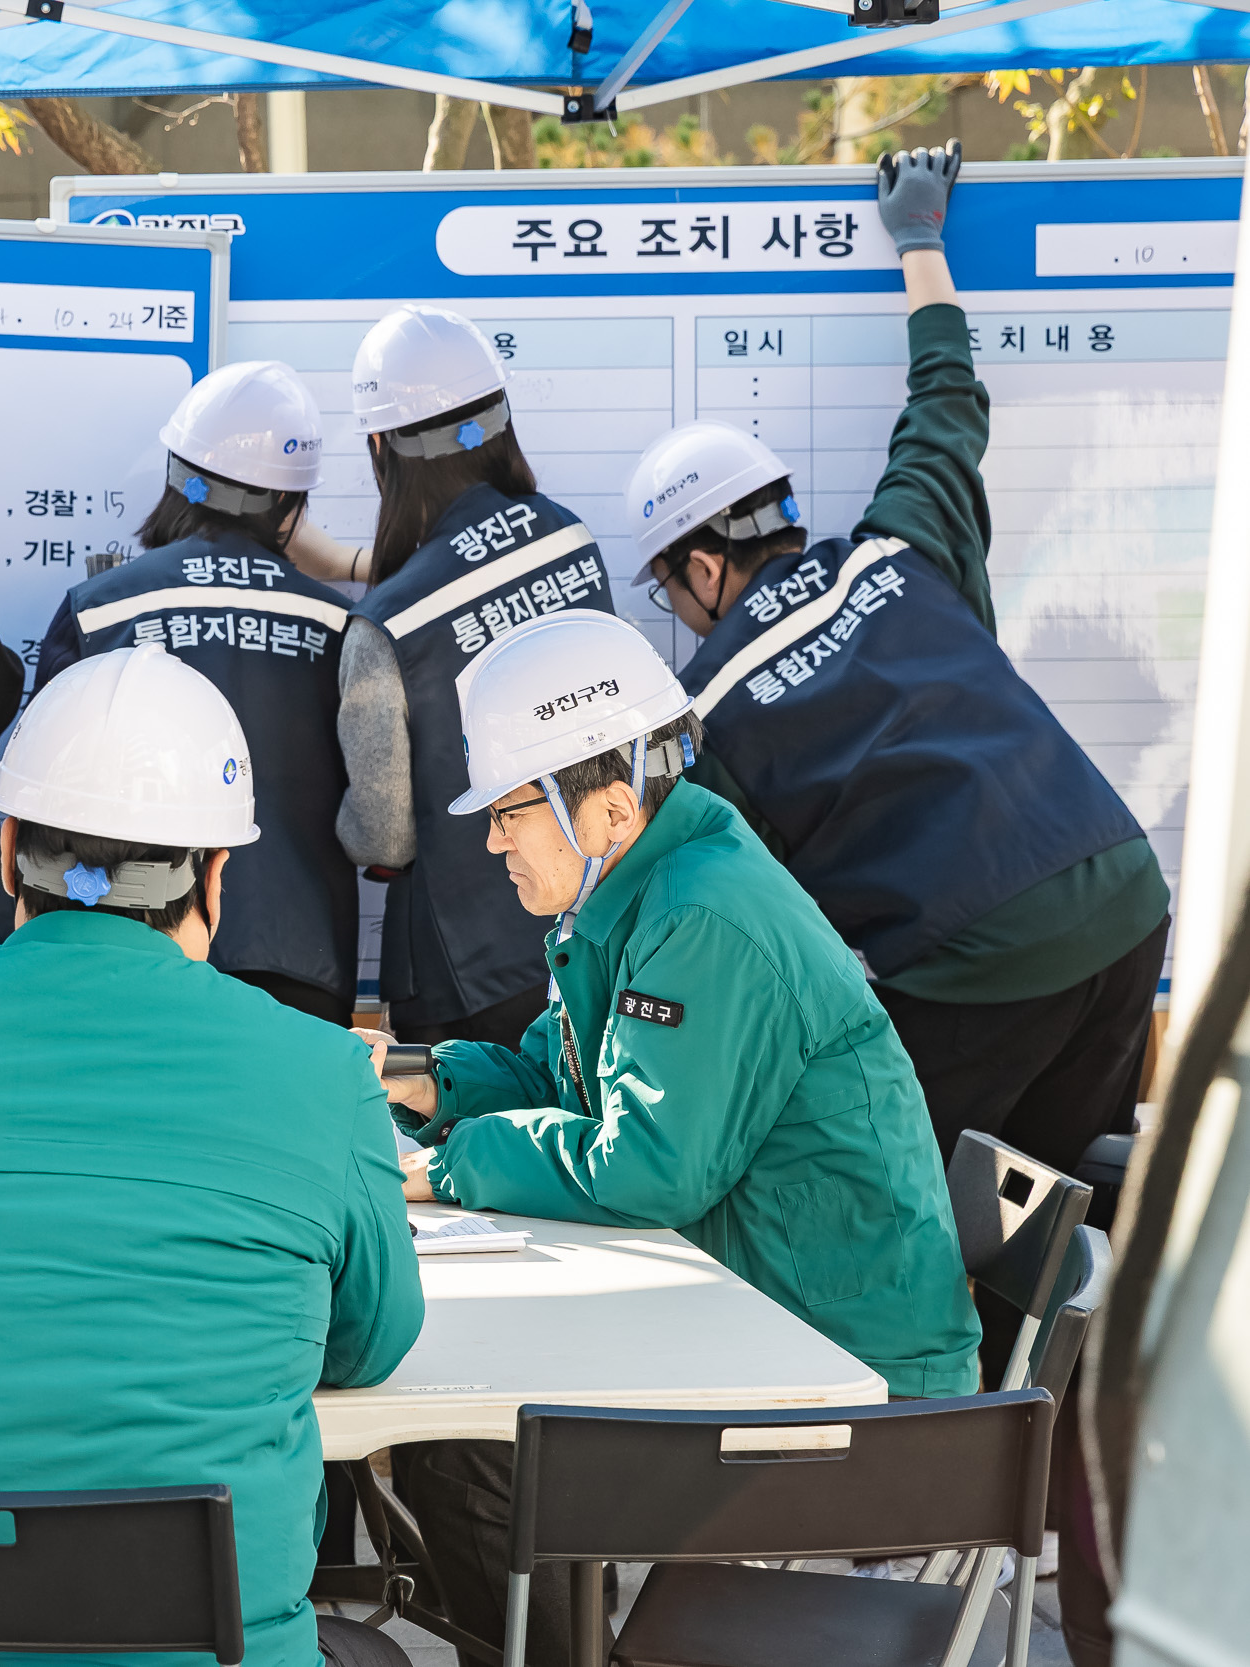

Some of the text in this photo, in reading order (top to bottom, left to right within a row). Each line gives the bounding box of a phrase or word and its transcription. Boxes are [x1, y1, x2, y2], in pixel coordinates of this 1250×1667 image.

[512, 213, 859, 262] 주요 조치 사항
[142, 304, 188, 329] 기준
[449, 502, 538, 563] 광진구
[182, 555, 286, 588] 광진구
[744, 558, 829, 623] 광진구
[451, 555, 603, 654] 통합지원본부
[133, 613, 329, 663] 통합지원본부
[745, 564, 907, 705] 통합지원본부
[533, 679, 620, 721] 광진구청
[624, 996, 672, 1022] 광진구
